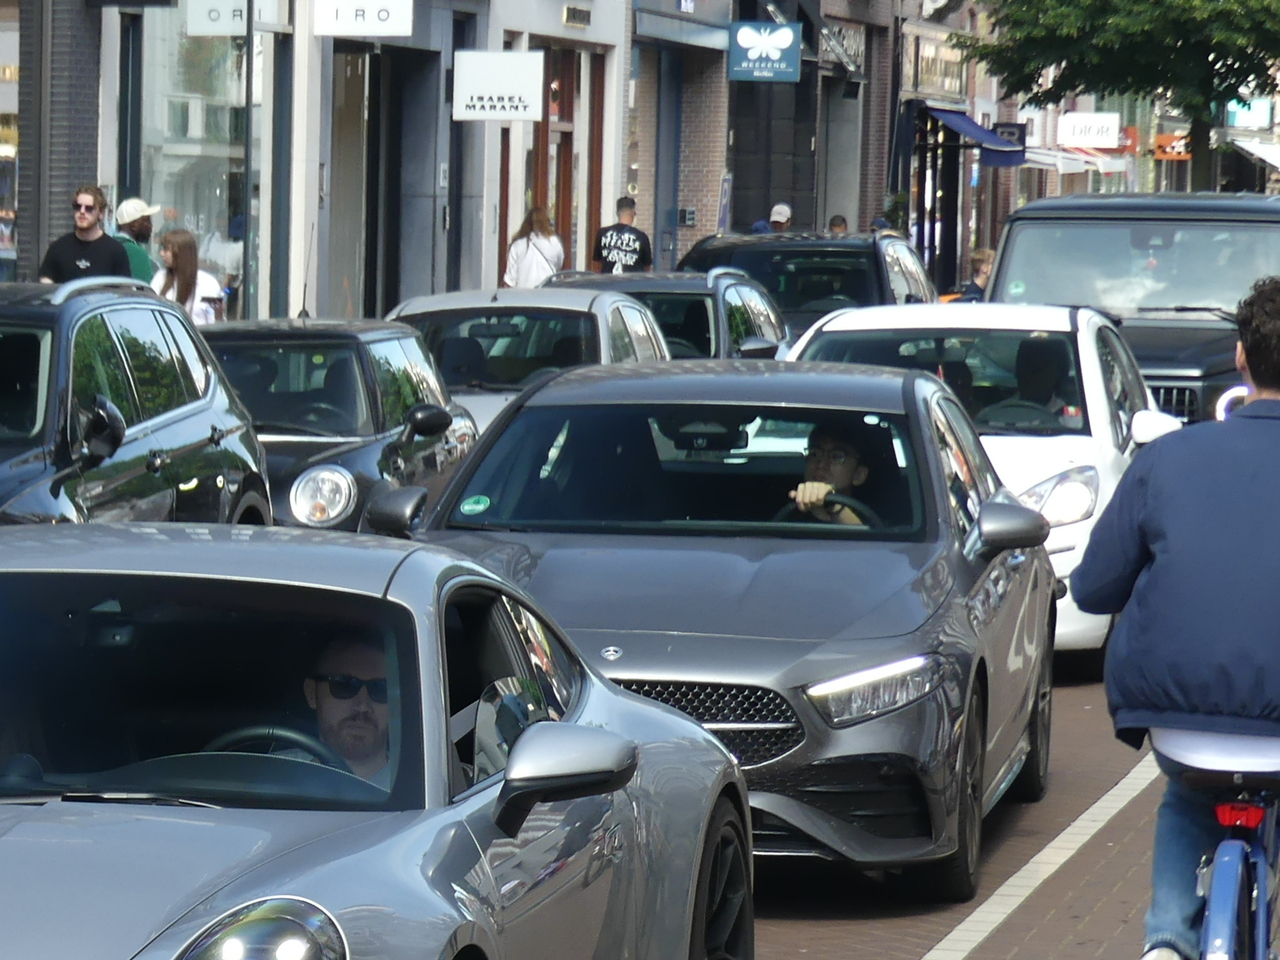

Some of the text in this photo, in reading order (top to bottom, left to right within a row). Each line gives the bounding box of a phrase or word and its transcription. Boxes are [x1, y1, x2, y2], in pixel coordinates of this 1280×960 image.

[335, 8, 390, 22] IRO
[741, 61, 787, 69] WEEKEND
[470, 95, 525, 103] ISABEL
[465, 104, 529, 112] MARANT
[1072, 125, 1110, 138] DIOR
